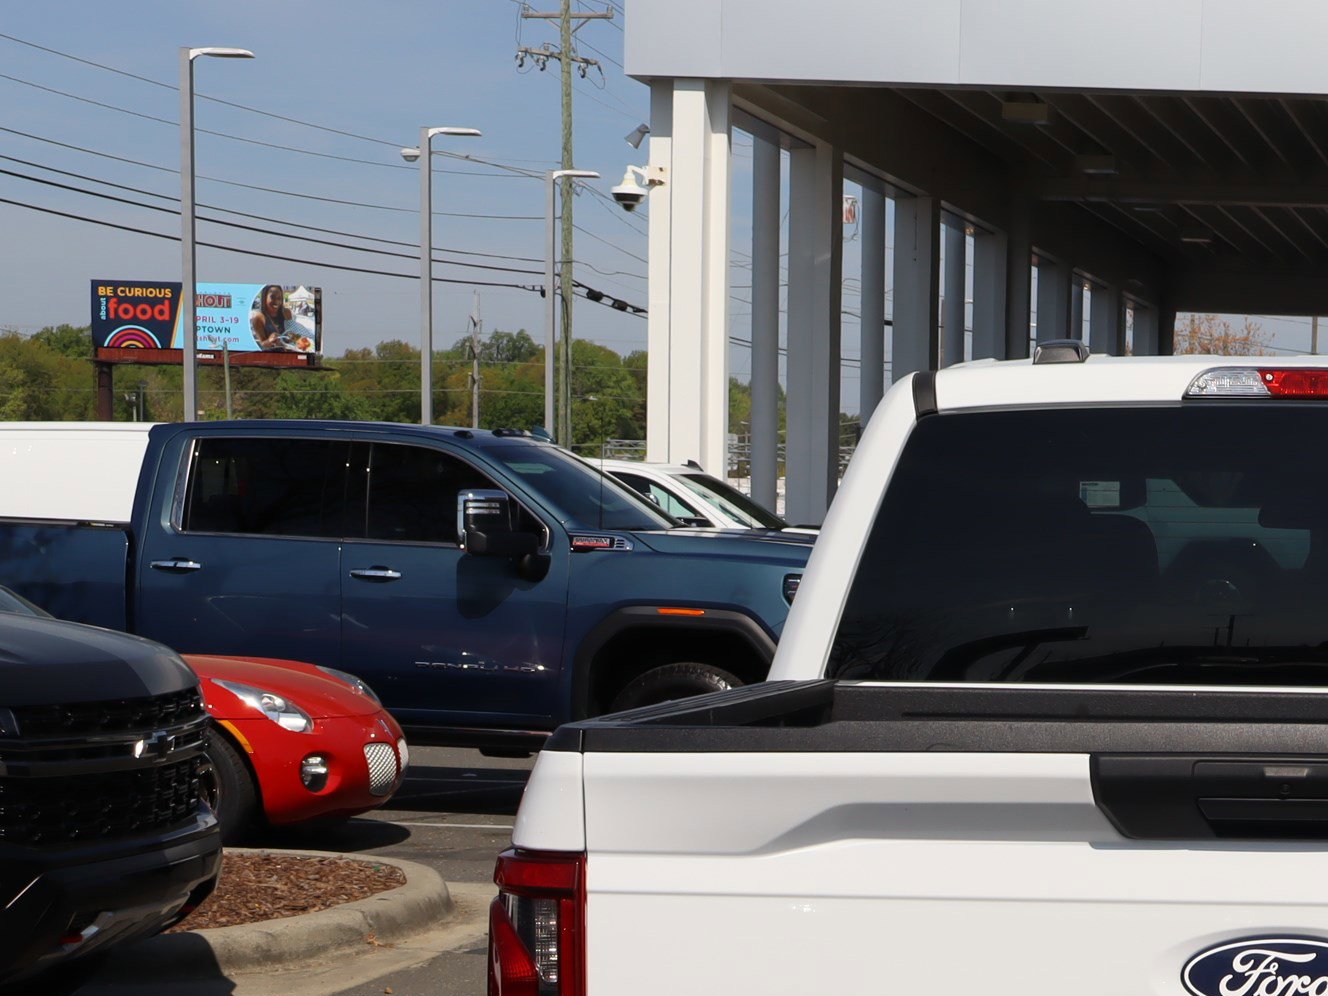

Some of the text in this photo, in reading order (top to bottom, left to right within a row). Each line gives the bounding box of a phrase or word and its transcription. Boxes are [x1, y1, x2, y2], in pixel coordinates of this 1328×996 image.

[98, 286, 172, 298] BE CURIOUS
[108, 298, 171, 320] food
[195, 315, 239, 324] PRIL 3-19
[195, 325, 231, 334] PTOWN
